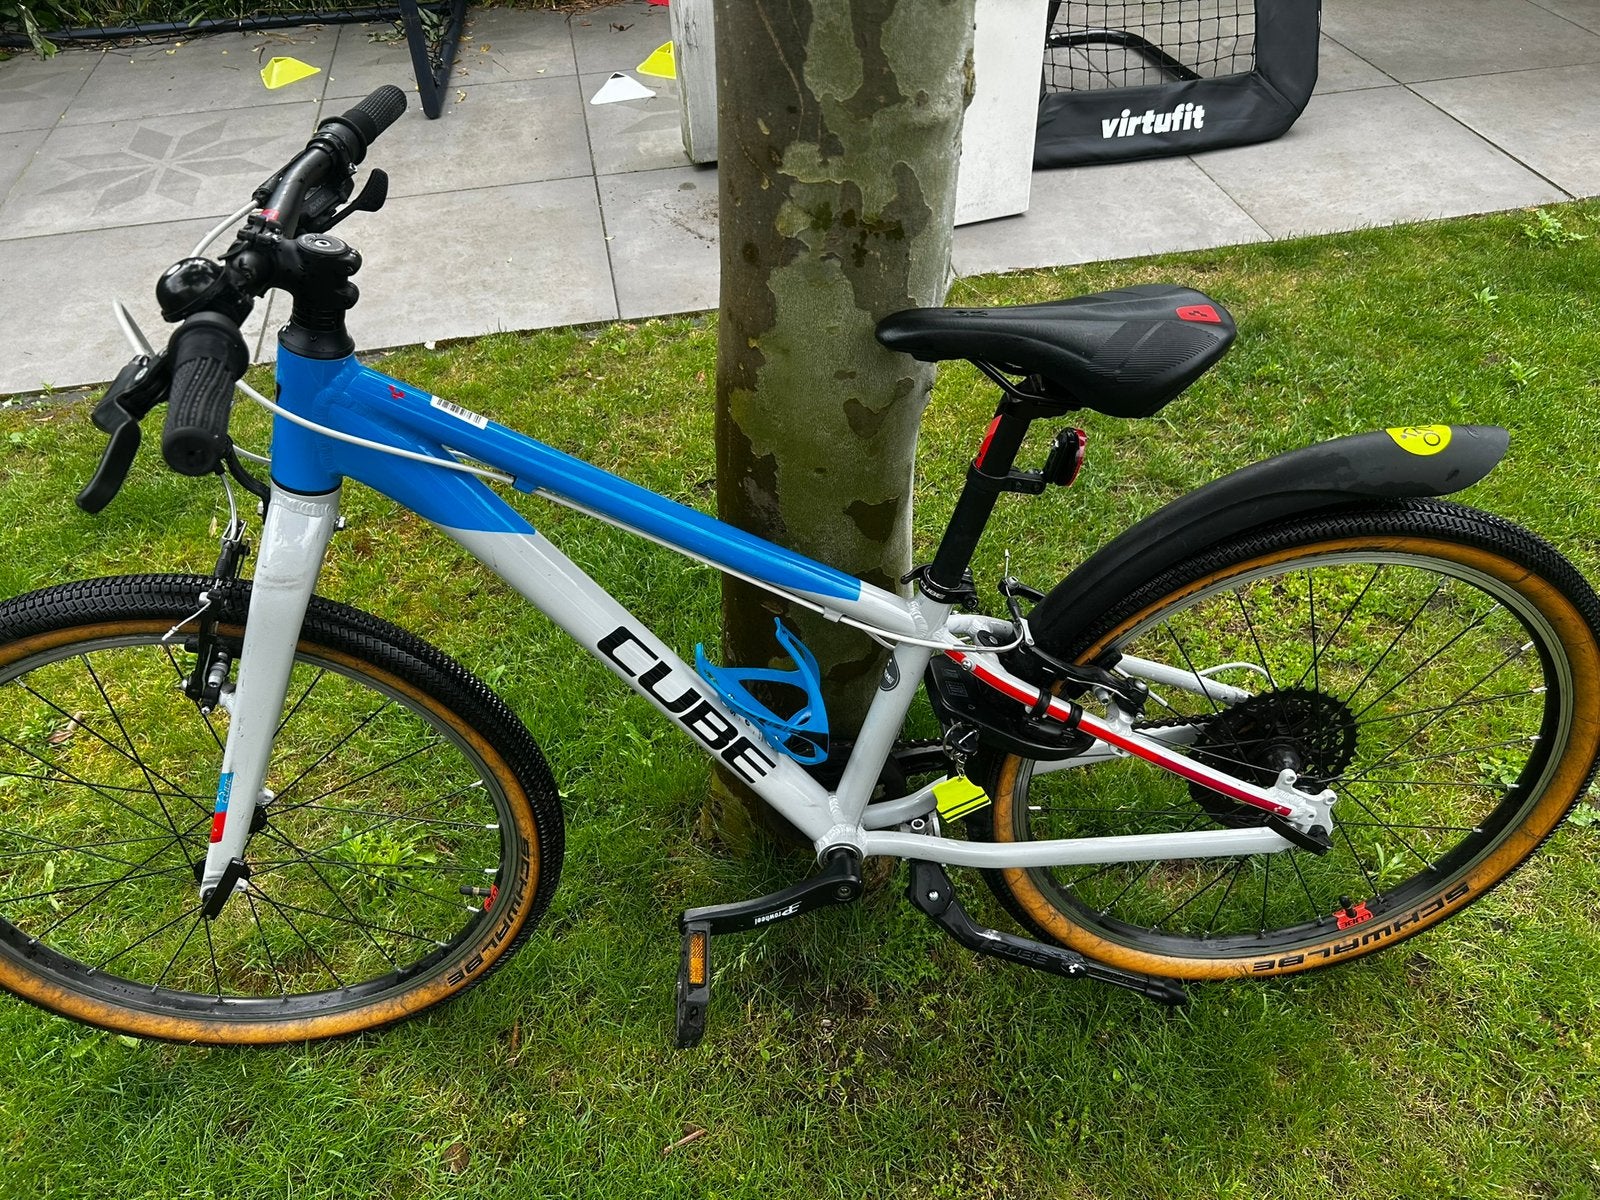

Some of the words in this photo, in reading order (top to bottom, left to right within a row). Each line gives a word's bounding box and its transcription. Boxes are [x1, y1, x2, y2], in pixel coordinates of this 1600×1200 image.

[1101, 102, 1206, 139] virtufit
[920, 579, 947, 600] CUBE
[596, 625, 777, 784] CUBE
[754, 900, 802, 926] Prowheel
[1252, 881, 1471, 972] SCHWALBE
